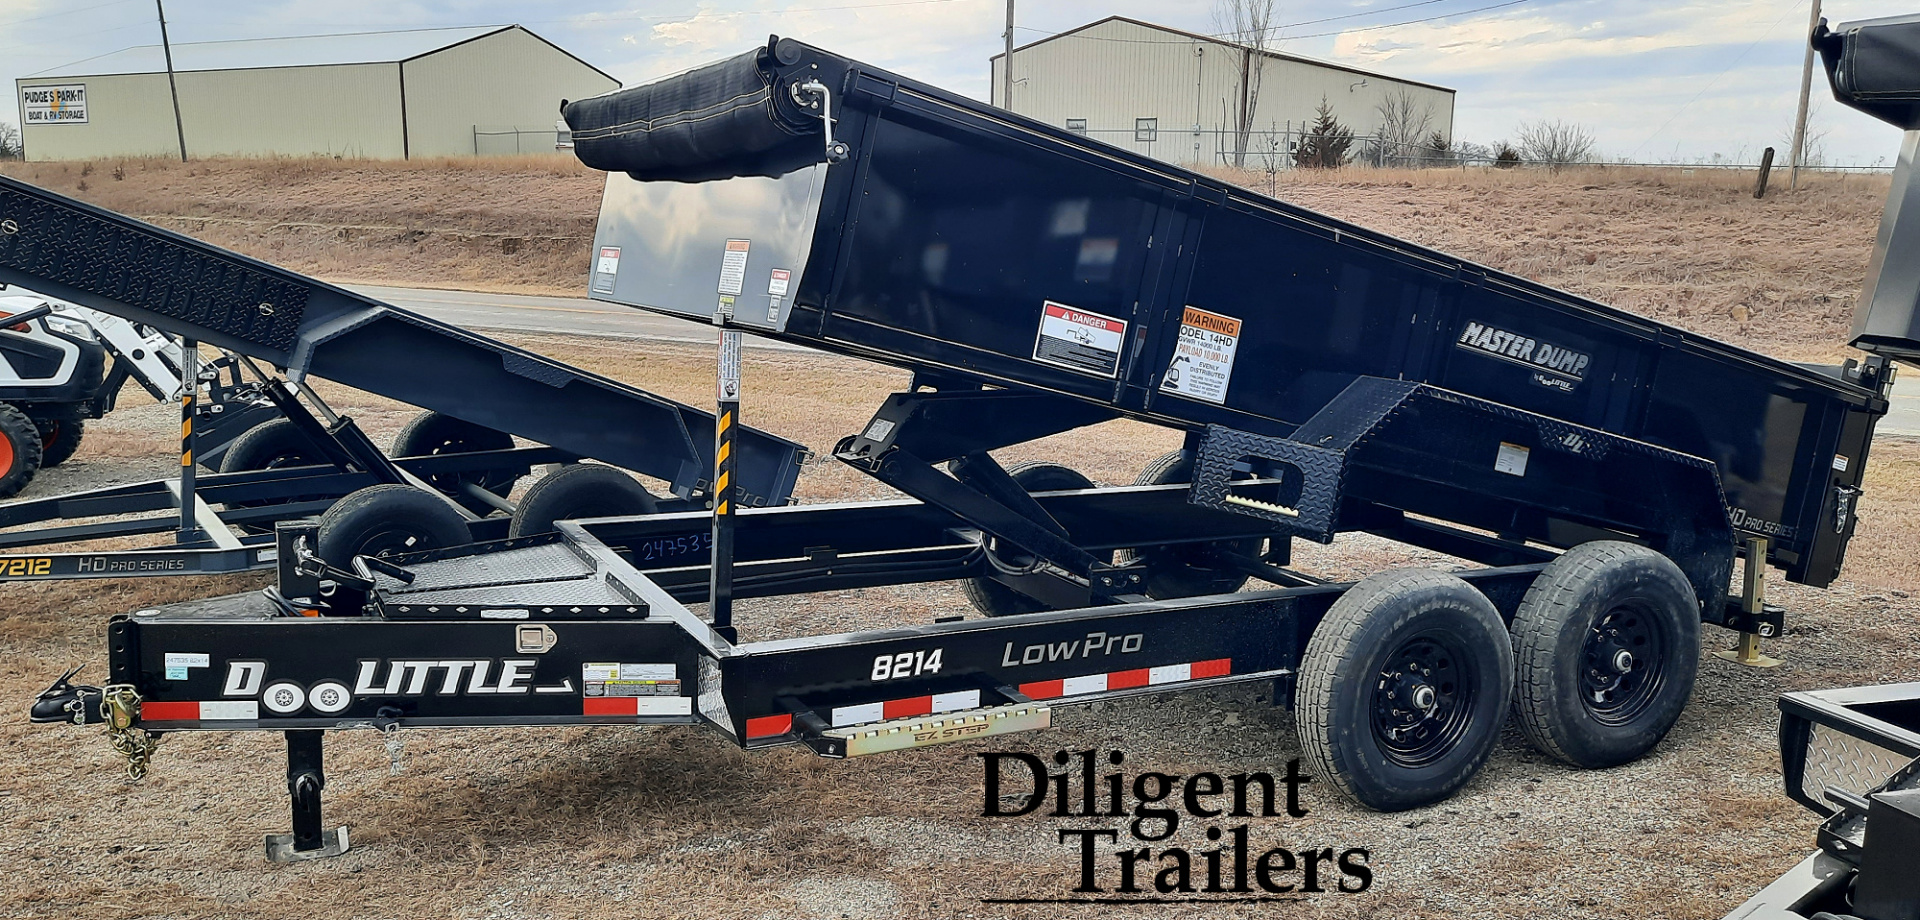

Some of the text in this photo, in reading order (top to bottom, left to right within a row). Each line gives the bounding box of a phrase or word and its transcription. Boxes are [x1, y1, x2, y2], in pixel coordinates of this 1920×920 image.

[28, 111, 42, 120] BOAT
[58, 110, 84, 119] STORAGE
[1072, 313, 1107, 329] DANGER
[1185, 311, 1235, 334] WARNING
[1180, 326, 1233, 347] ODEL 14HD
[1460, 322, 1536, 361] MASTER
[1179, 343, 1203, 357] PAYLOAD
[1190, 366, 1225, 379] DISTRIBUTED
[1199, 361, 1219, 371] EVENLY
[1744, 516, 1764, 531] PRO
[1763, 521, 1794, 537] SERIES
[642, 533, 713, 560] 247535
[78, 557, 107, 572] HD
[110, 560, 136, 571] PRO
[139, 559, 185, 571] SERIES
[871, 648, 944, 681] 8214
[914, 723, 990, 742] EZ STEP
